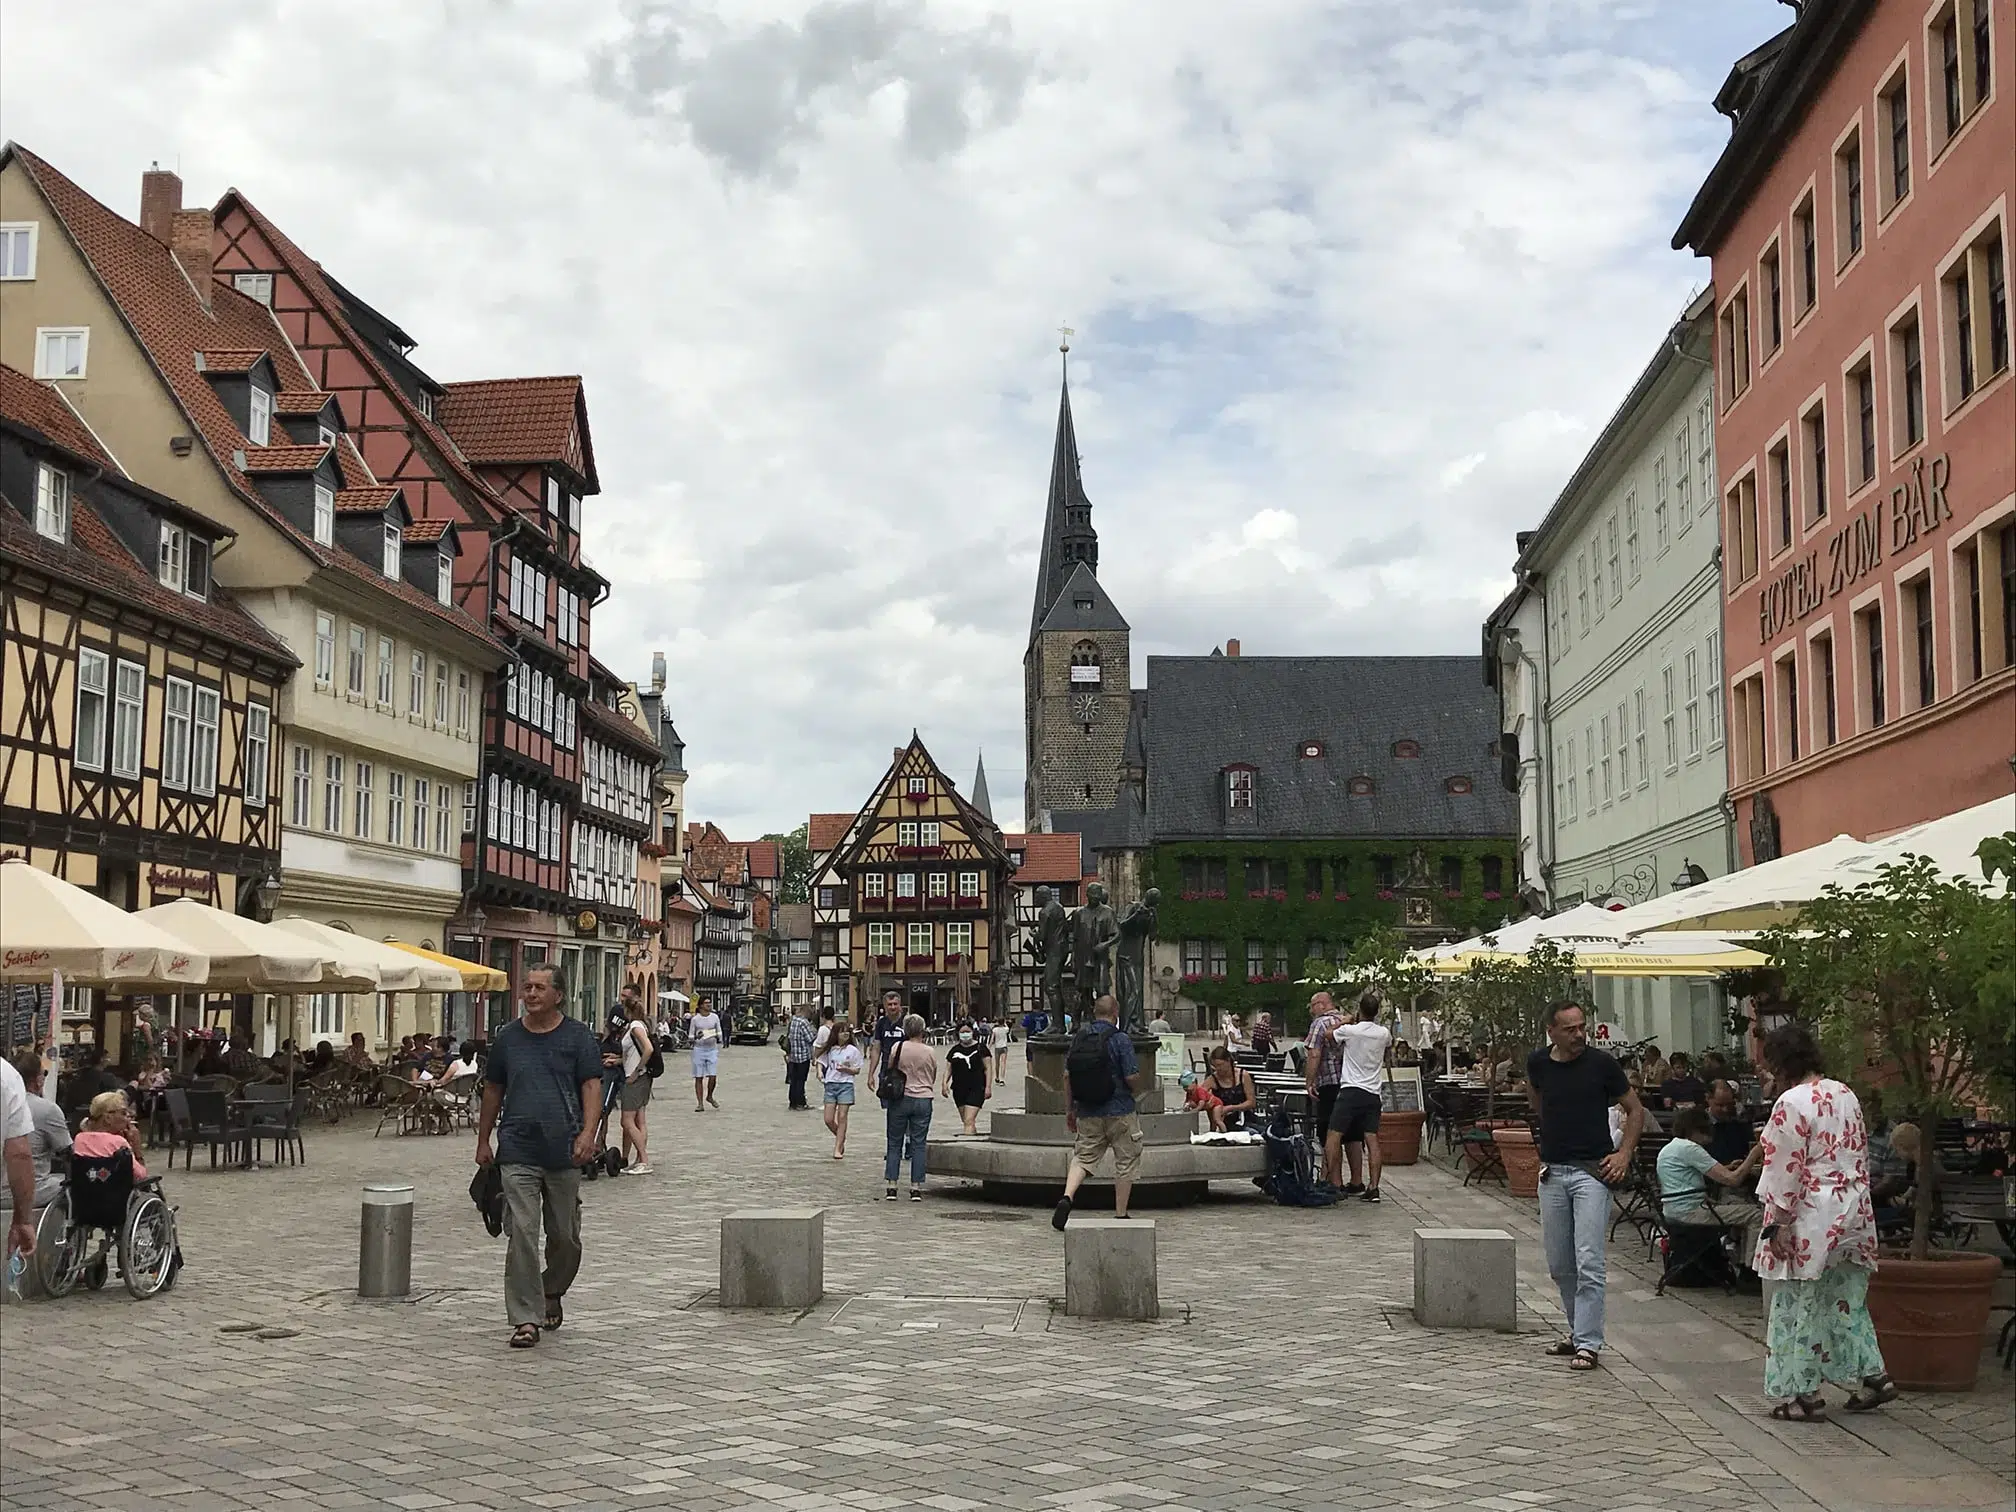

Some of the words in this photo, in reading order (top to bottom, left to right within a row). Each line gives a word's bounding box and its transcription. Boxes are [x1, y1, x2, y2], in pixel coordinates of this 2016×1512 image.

[1759, 550, 1824, 645] HOTEL
[1828, 500, 1883, 598] ZUM
[1890, 452, 1953, 556] BÄR
[3, 950, 49, 969] Schäfer's
